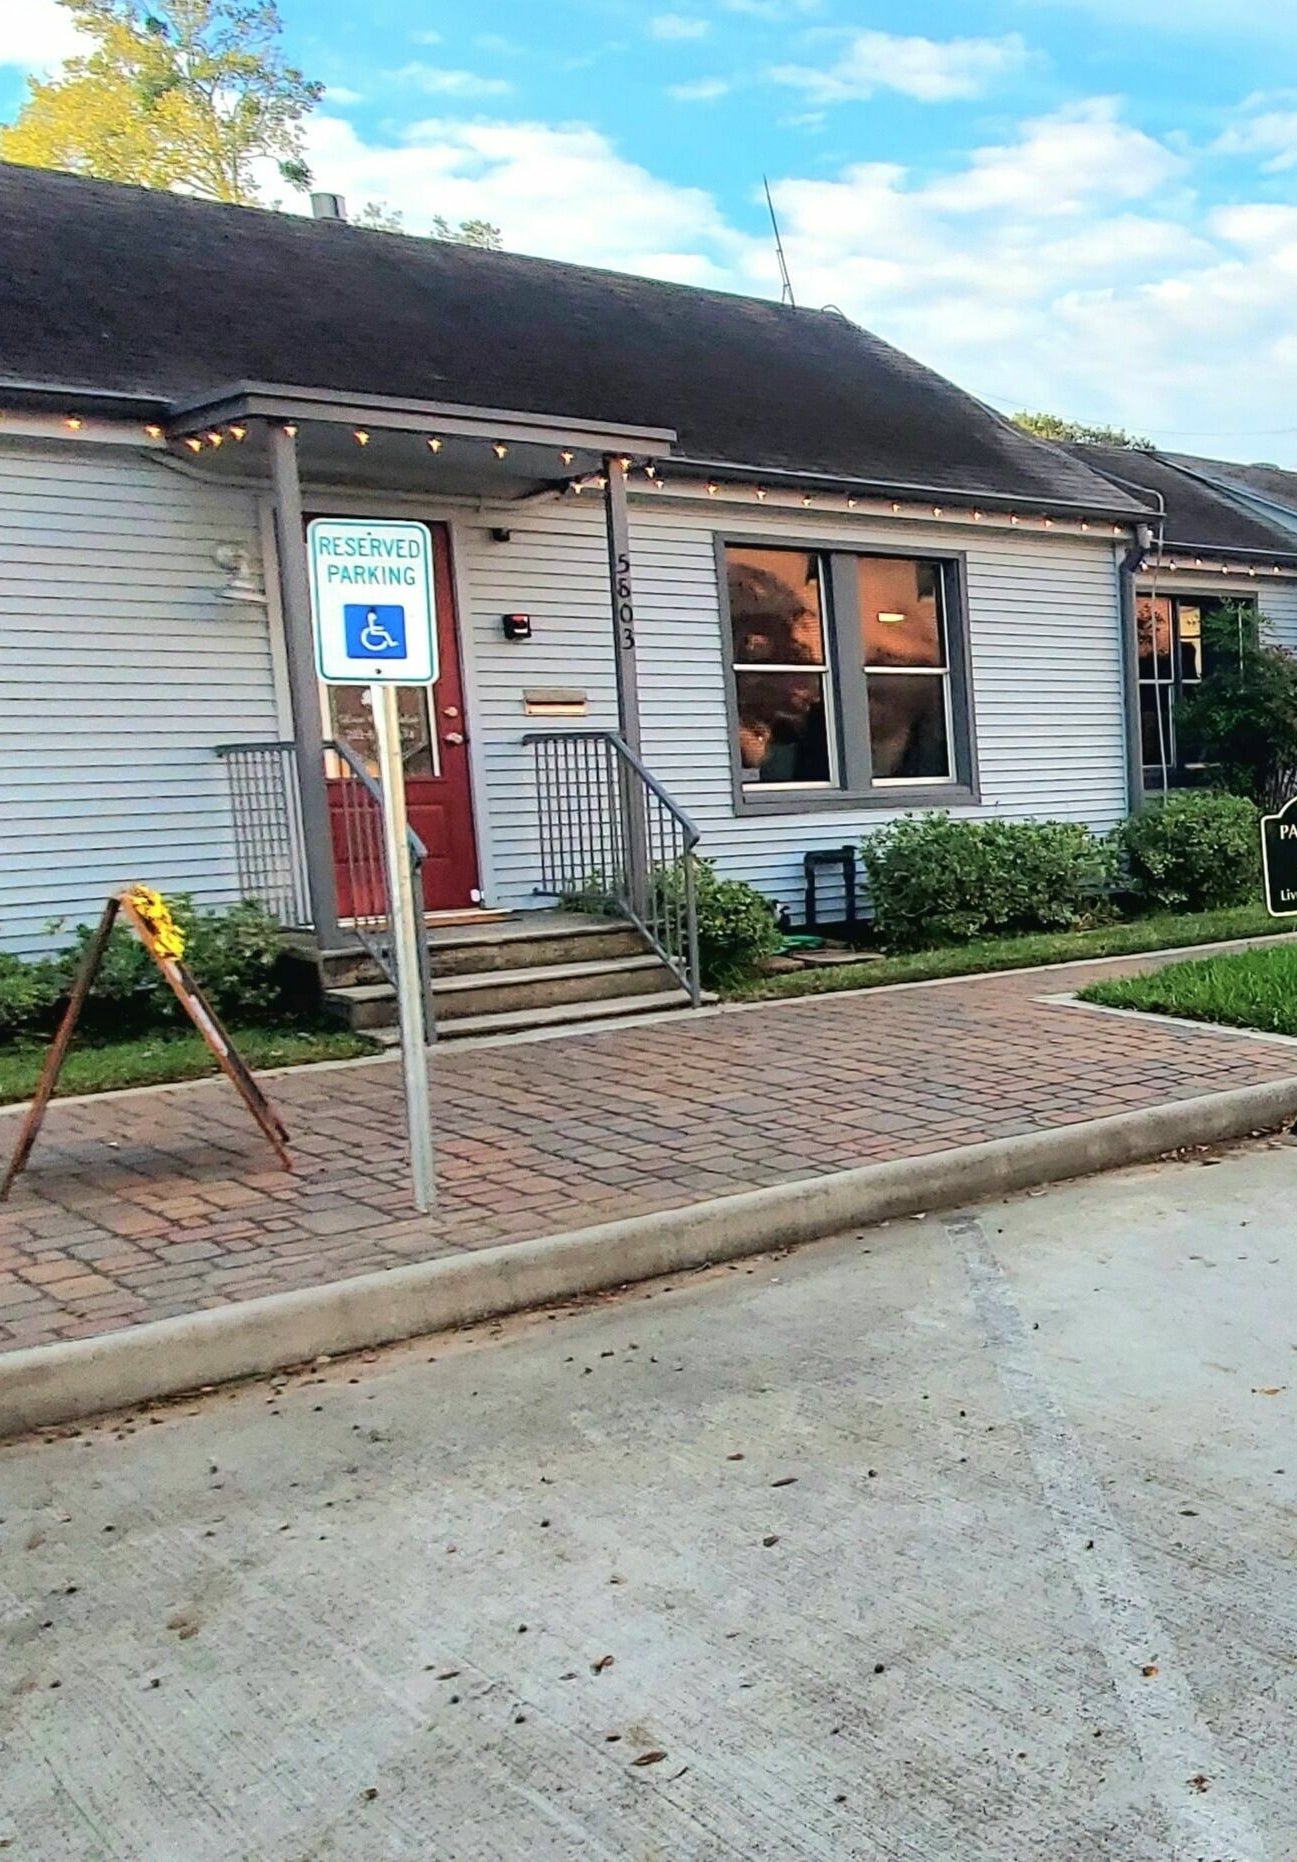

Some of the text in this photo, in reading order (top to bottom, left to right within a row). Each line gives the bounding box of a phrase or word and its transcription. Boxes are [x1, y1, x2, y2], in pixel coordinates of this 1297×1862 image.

[319, 536, 421, 559] RESERVED
[327, 564, 416, 586] PARKING
[616, 553, 635, 650] 5603
